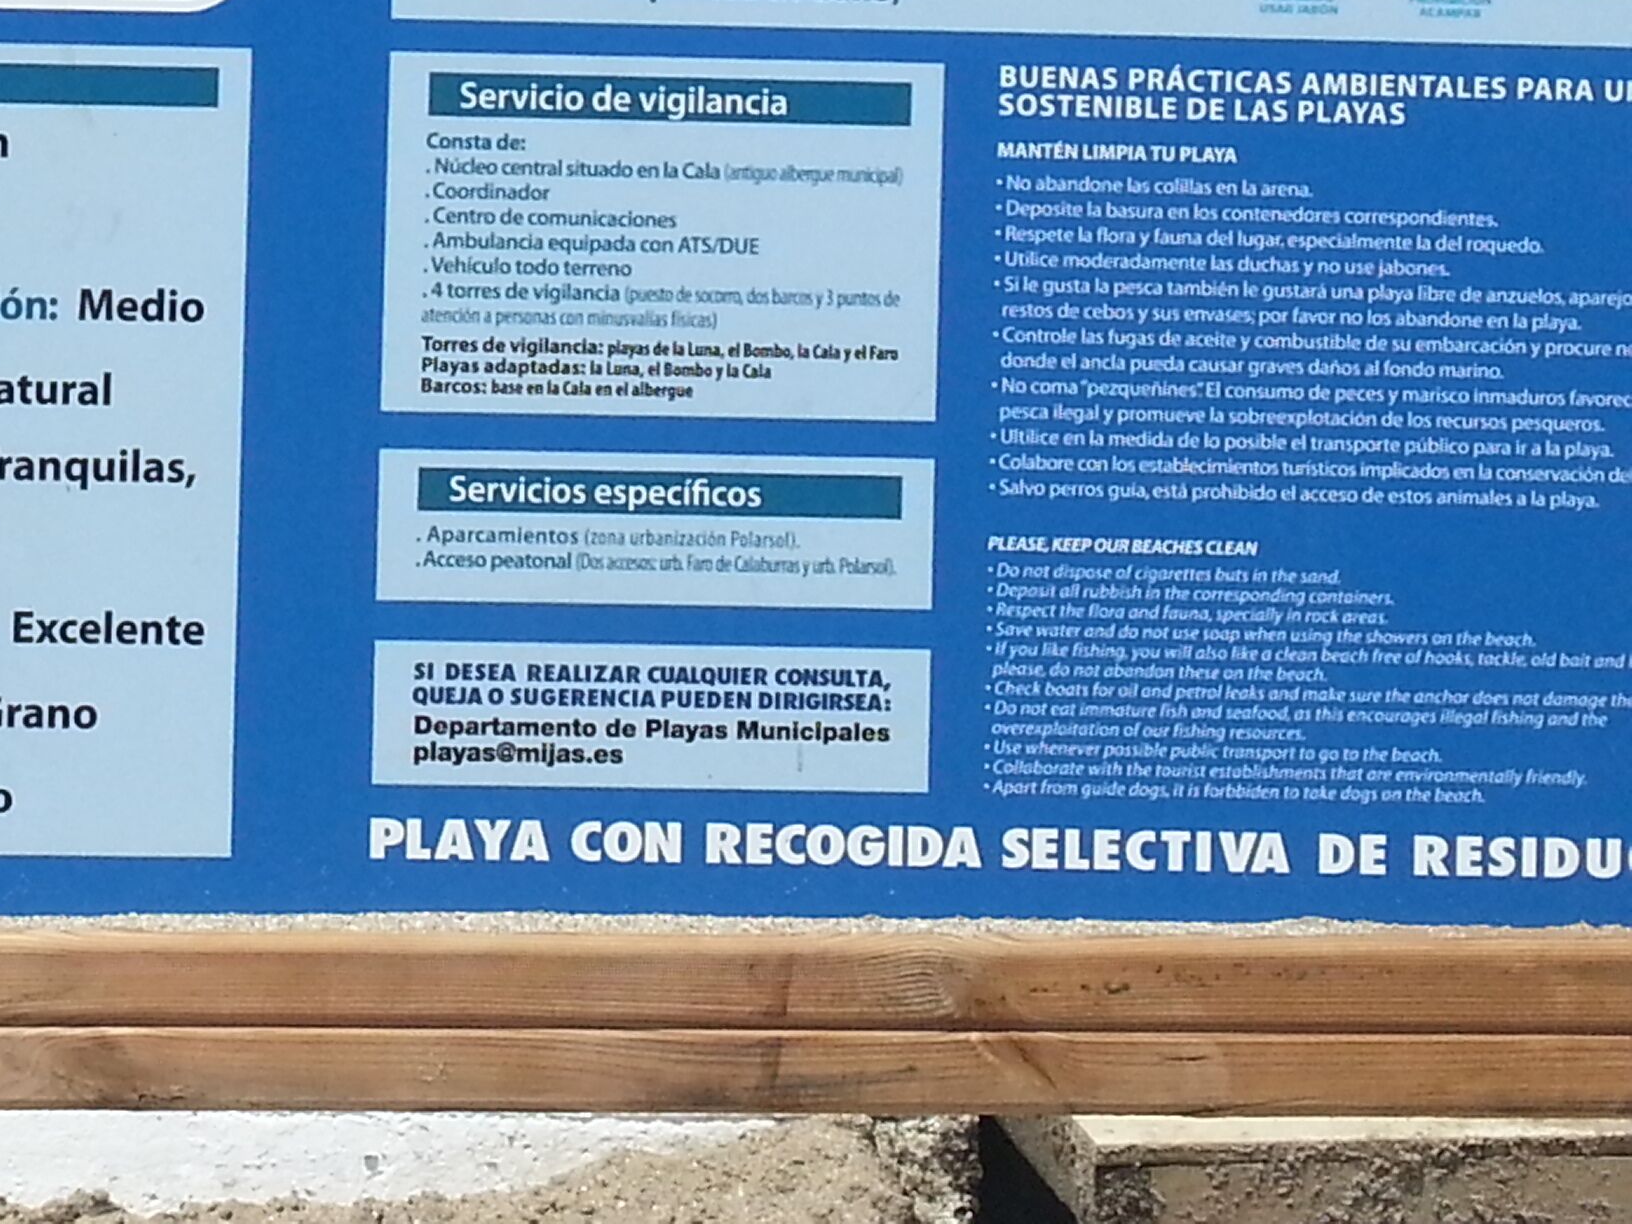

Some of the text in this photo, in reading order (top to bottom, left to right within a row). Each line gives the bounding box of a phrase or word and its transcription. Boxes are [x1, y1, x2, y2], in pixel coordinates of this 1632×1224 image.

[1000, 65, 1117, 89] BUENAS
[1128, 64, 1291, 94] PRÁCTICAS
[1301, 72, 1506, 99] AMBIENTALES
[1517, 77, 1593, 101] PARA
[460, 81, 787, 120] Servicio de vigilancia
[998, 93, 1404, 124] SOSTENIBLE DE LAS PLAYAS
[426, 132, 525, 150] Consta de:
[997, 140, 1237, 163] MANTÉN LIMPIA TU PLAYA
[432, 181, 549, 201] Coordinador
[1006, 174, 1312, 197] No abandone las colillas en la arena.
[433, 206, 676, 228] Centro de comunicaciones
[78, 287, 204, 322] Medio
[449, 475, 761, 511] Servicios específicos
[987, 535, 1257, 555] PLEASE, KEEP OUR BEACHES CLEAN
[13, 610, 204, 645] Excelente
[414, 715, 889, 745] Departamento de Playas Municipales
[413, 740, 623, 767] playas@mijas.es
[369, 817, 1632, 878] PLAYA CON RECOGIDA SELECTIVA DE RESIDU
